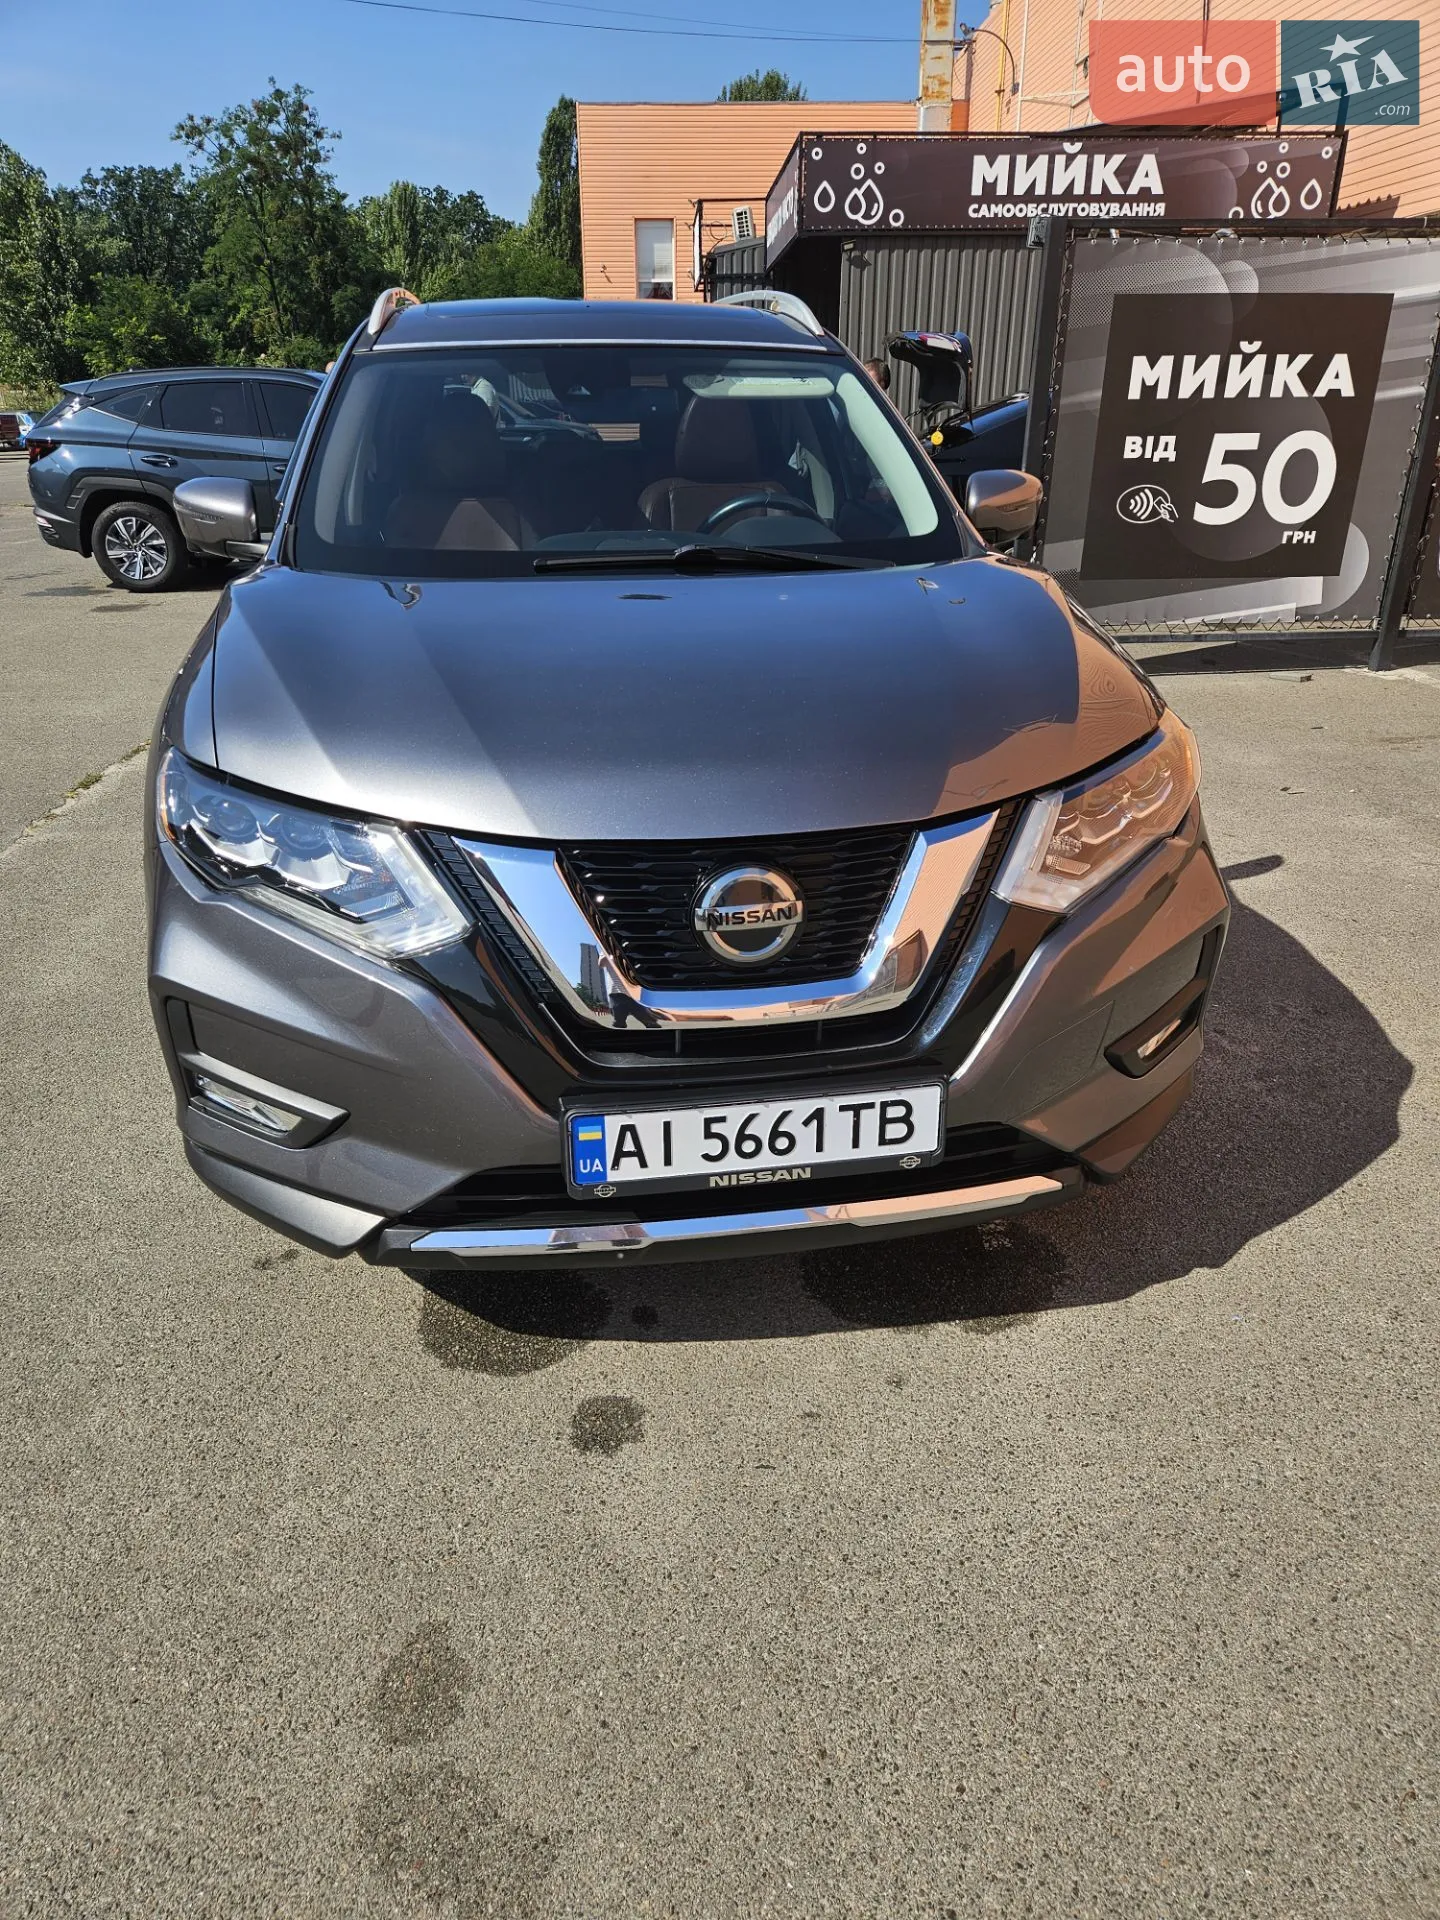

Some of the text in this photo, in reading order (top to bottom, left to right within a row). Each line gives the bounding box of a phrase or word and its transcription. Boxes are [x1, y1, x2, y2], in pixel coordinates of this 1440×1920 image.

[970, 142, 1164, 196] МИЙКА
[968, 202, 1166, 218] САМООБСЛУГОВУВАННЯ
[1127, 341, 1355, 400] МИЙКА
[1123, 430, 1337, 526] ВІД 50
[1281, 530, 1317, 545] ГРН
[707, 905, 793, 928] NISSAN
[579, 1158, 604, 1174] UA
[709, 1167, 813, 1188] NISSAN
